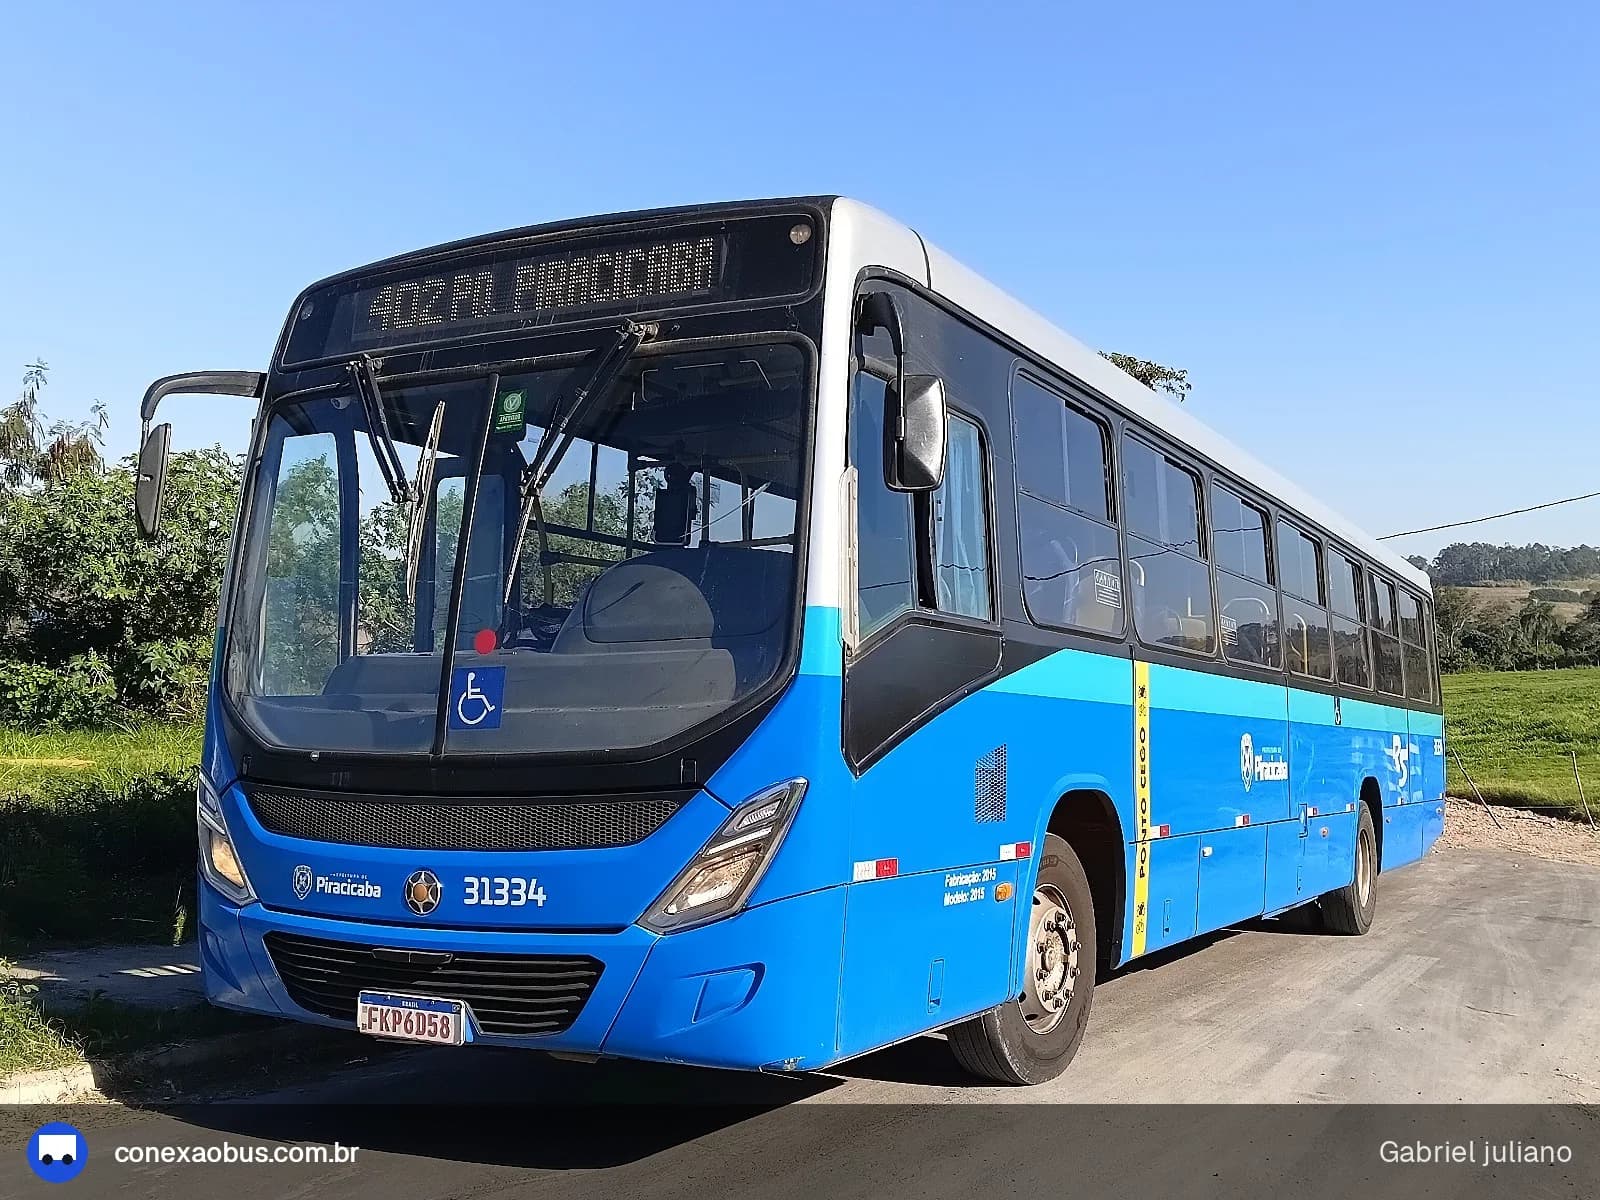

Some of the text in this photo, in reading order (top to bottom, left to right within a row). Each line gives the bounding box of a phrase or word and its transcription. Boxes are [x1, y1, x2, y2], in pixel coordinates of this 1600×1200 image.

[369, 278, 446, 331] 402
[513, 237, 714, 313] PIRACICABA
[1139, 726, 1147, 878] PONTO CEGO
[316, 876, 382, 898] Piracicaba
[982, 867, 997, 882] 2015
[463, 876, 547, 907] 31334
[944, 886, 986, 907] Modelo: 2015
[367, 1006, 451, 1039] FKP6D58
